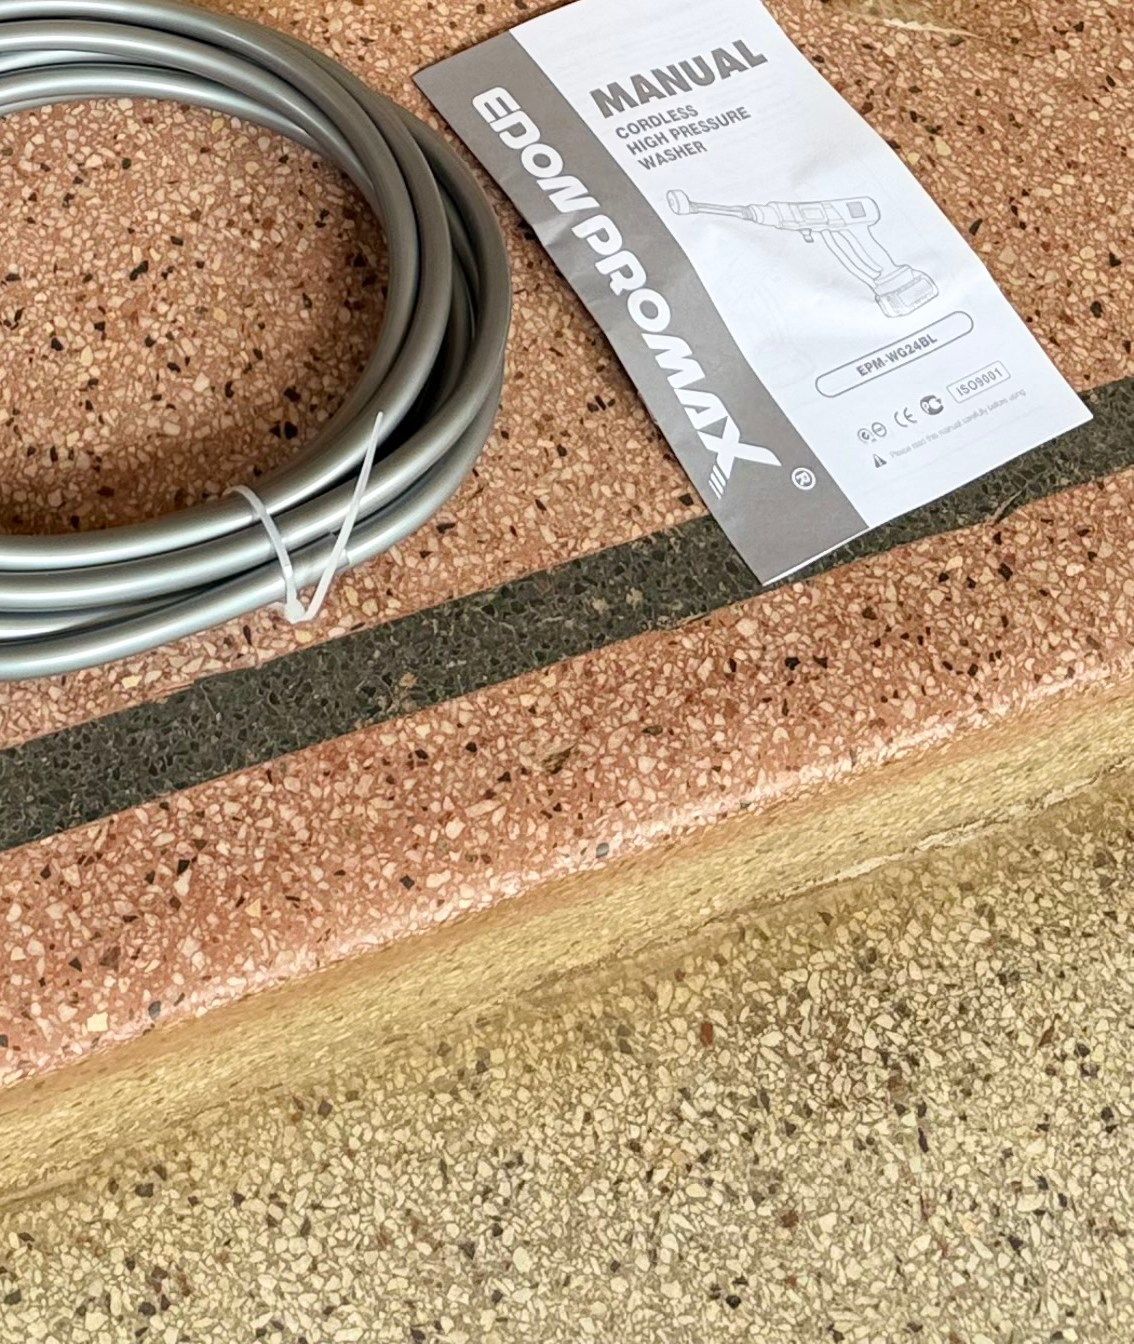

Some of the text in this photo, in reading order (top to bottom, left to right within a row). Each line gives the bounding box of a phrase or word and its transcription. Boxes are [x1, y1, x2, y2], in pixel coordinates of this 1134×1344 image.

[589, 39, 768, 119] MANUAL
[616, 105, 698, 139] CORDLESS
[626, 106, 752, 156] HIGH PRESSURE
[637, 140, 708, 170] WASHER
[472, 86, 601, 214] EDON
[571, 214, 782, 499] PROMAX
[856, 333, 938, 377] EPM-WG24BL
[955, 367, 1004, 397] ISO9001
[938, 421, 962, 436] manual
[962, 407, 988, 425] carefully
